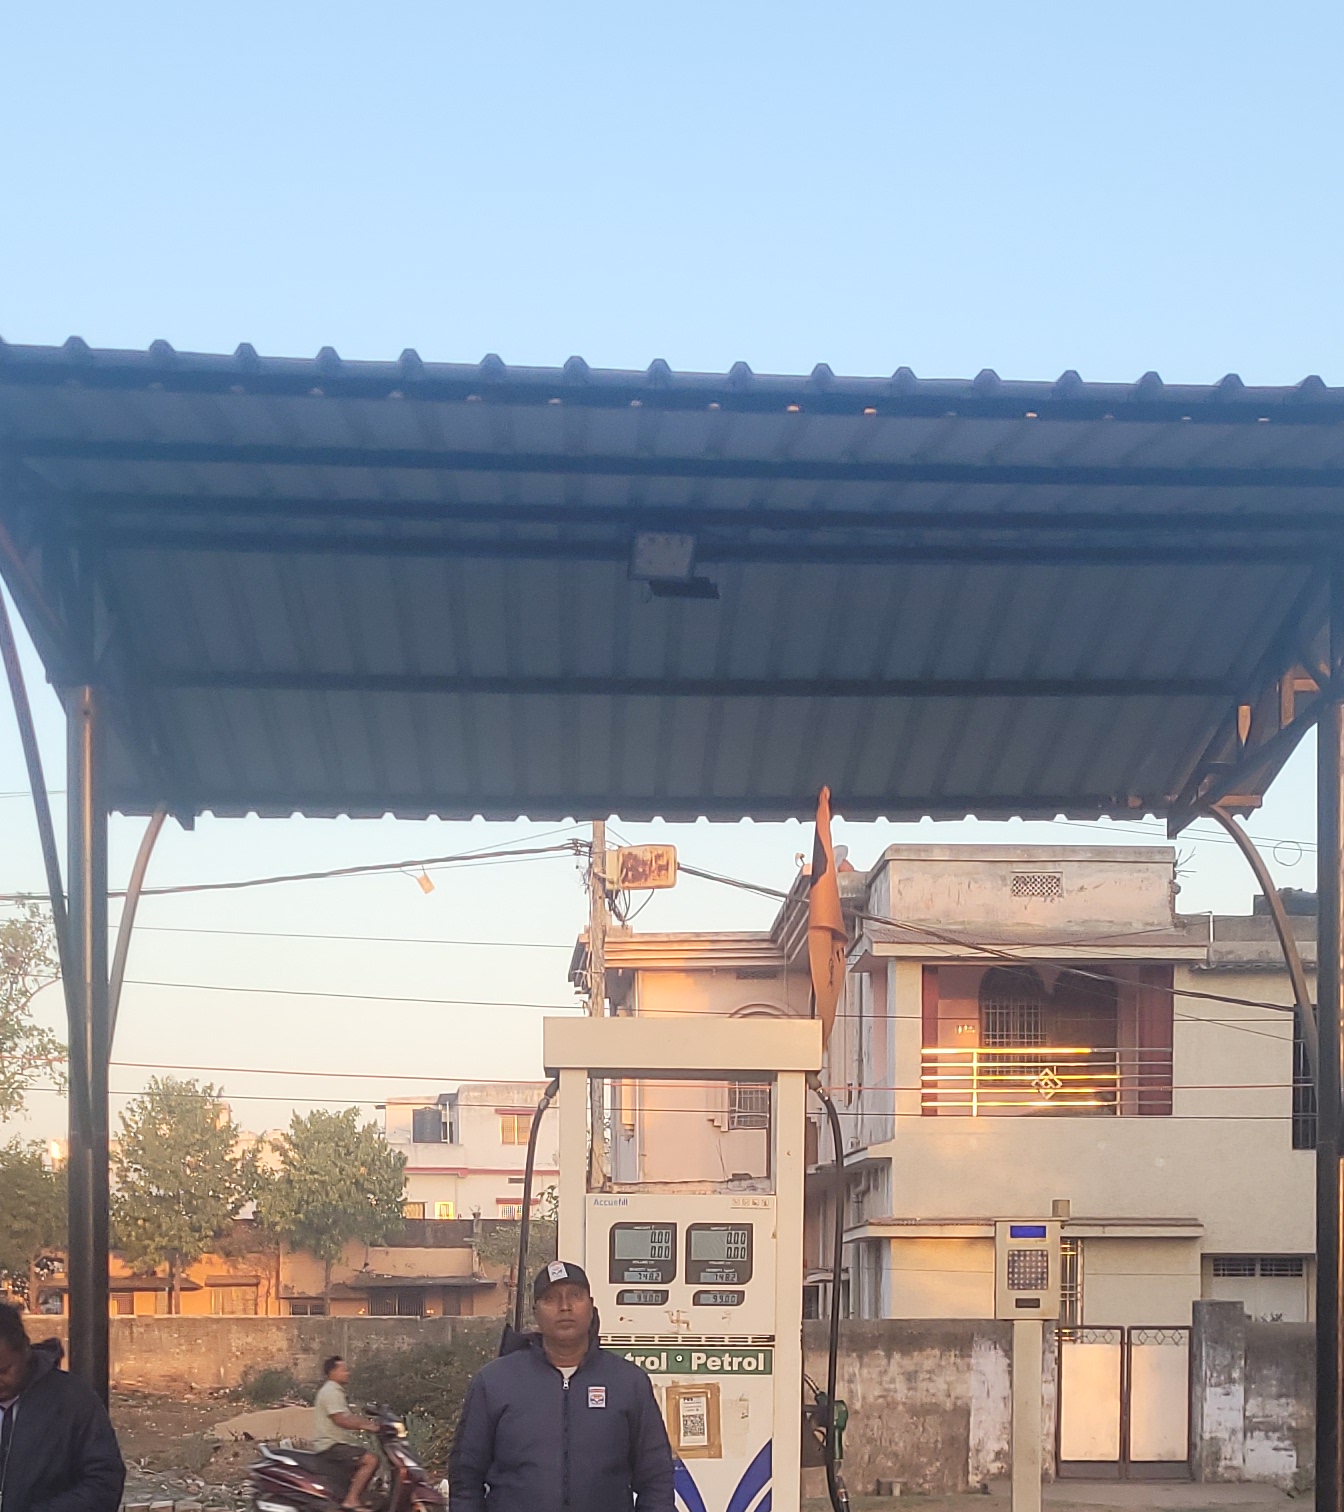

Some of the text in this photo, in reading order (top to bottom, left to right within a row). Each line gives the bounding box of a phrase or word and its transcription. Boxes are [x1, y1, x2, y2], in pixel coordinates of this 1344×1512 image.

[650, 1231, 670, 1244] 0.00
[726, 1232, 746, 1245] 0.00
[650, 1245, 670, 1259] 0.00
[726, 1246, 746, 1259] 0.00
[624, 1352, 765, 1371] trol Petrol
